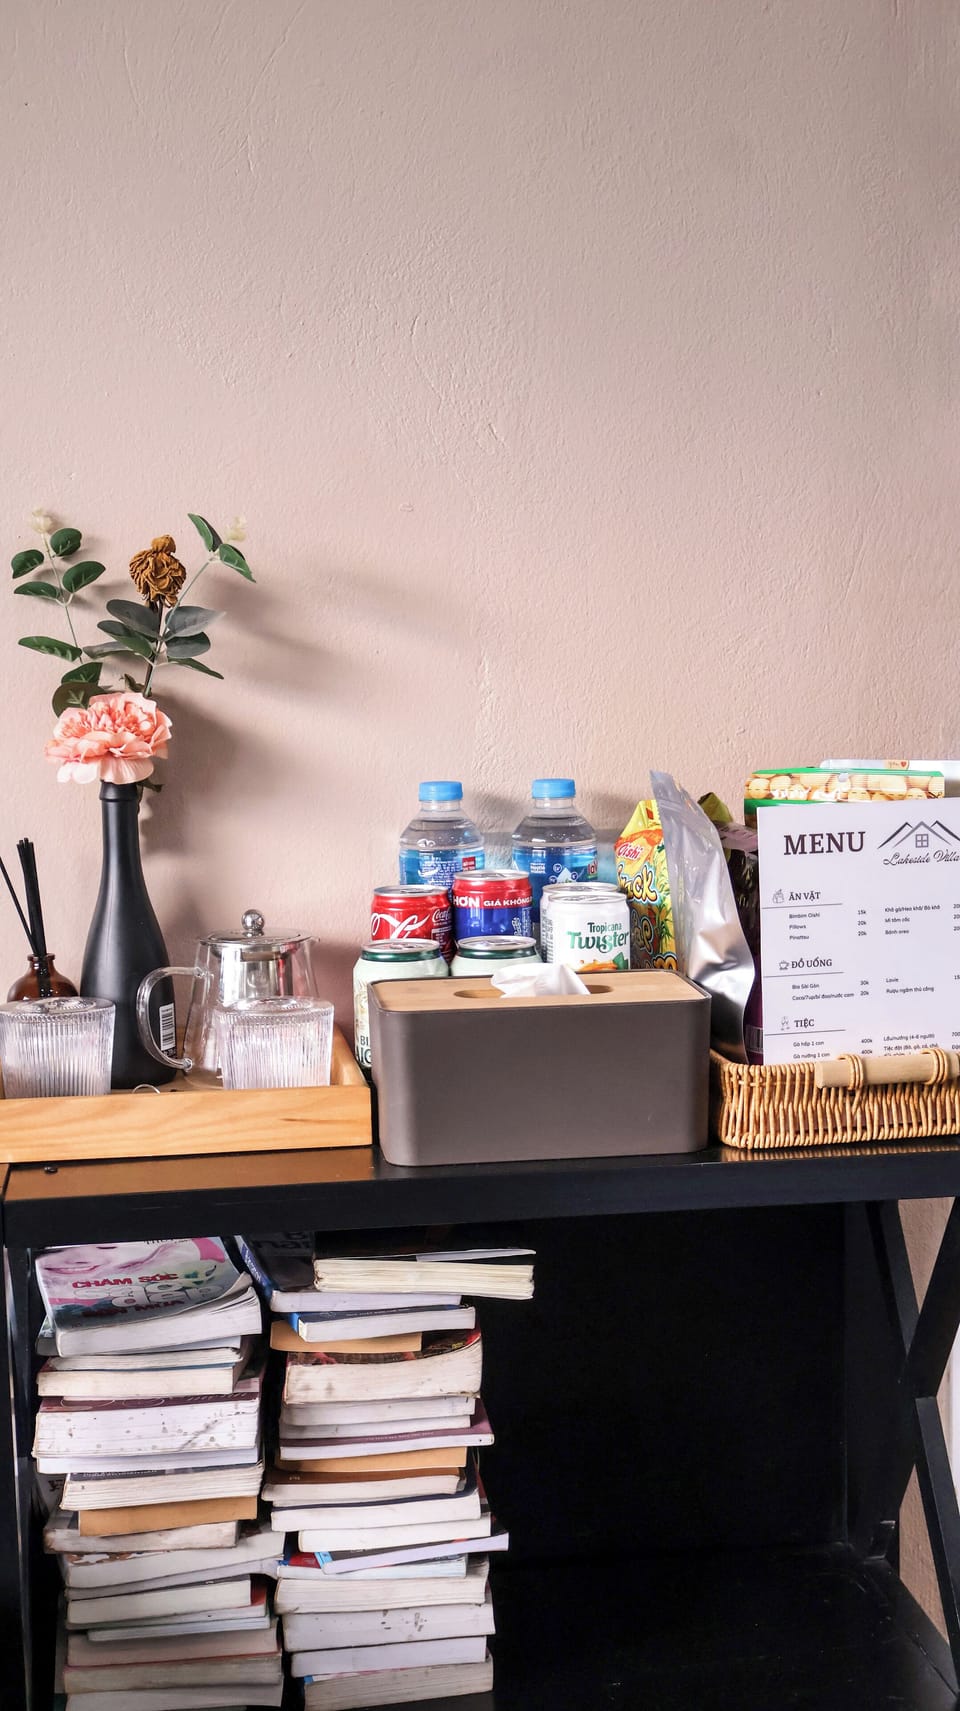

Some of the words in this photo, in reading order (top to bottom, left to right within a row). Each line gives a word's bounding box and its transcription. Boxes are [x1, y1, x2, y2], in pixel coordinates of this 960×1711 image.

[784, 831, 866, 855] MENU
[618, 842, 643, 860] Oishi
[883, 852, 930, 866] Lakeside
[933, 849, 960, 862] Villa
[453, 895, 480, 907] HƠN
[483, 899, 501, 907] GIÁ
[587, 922, 622, 934] Tropicana
[567, 931, 629, 953] Twister
[806, 956, 833, 968] UỐNG
[794, 1018, 815, 1029] TIỆC
